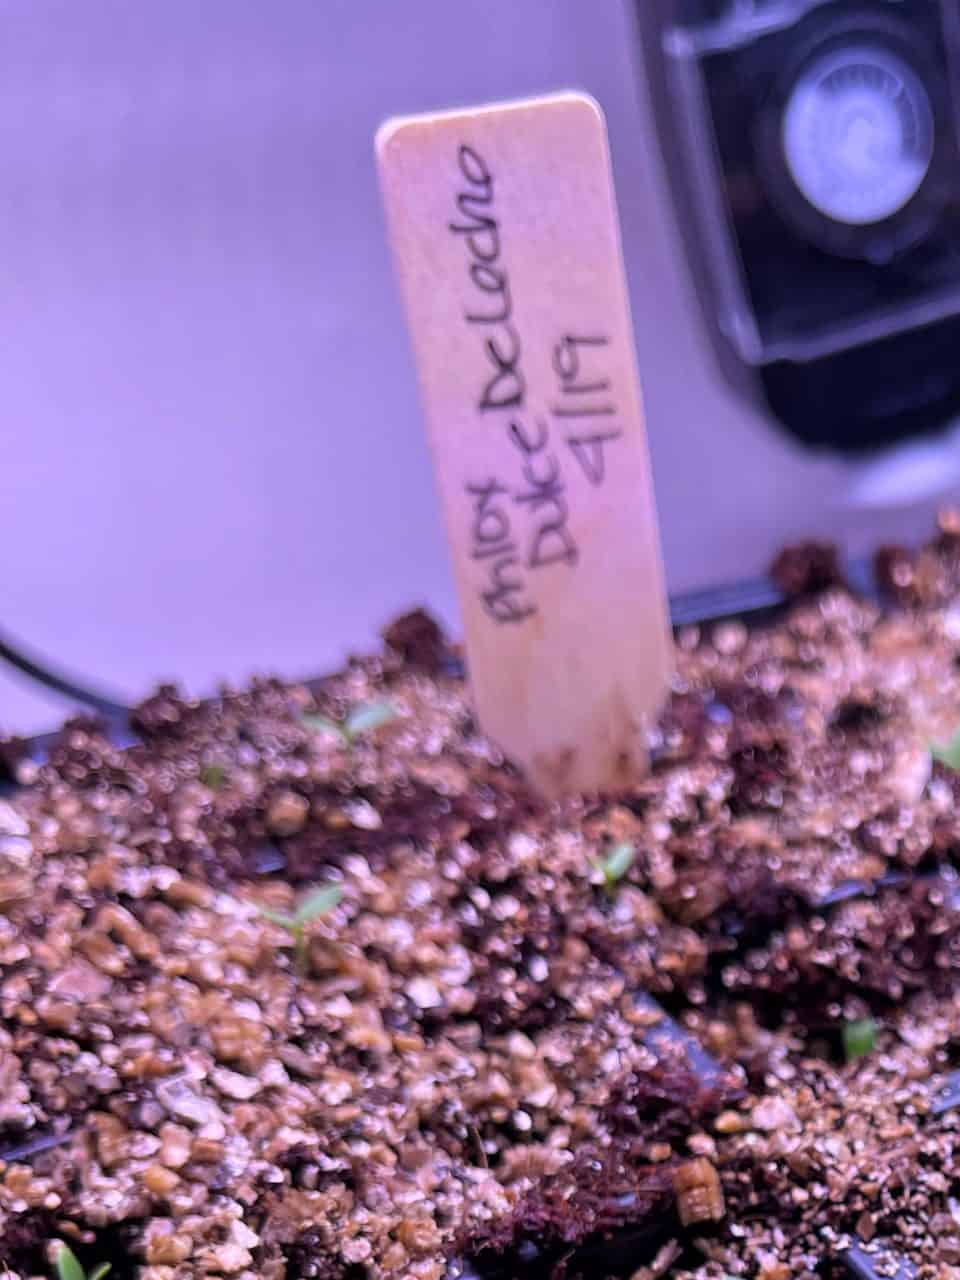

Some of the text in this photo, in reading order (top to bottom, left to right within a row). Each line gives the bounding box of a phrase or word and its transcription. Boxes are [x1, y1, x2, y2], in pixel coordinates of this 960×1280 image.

[478, 324, 526, 411] De
[552, 334, 621, 486] 4/19
[466, 478, 537, 624] Phlox
[508, 415, 577, 568] Dulce
